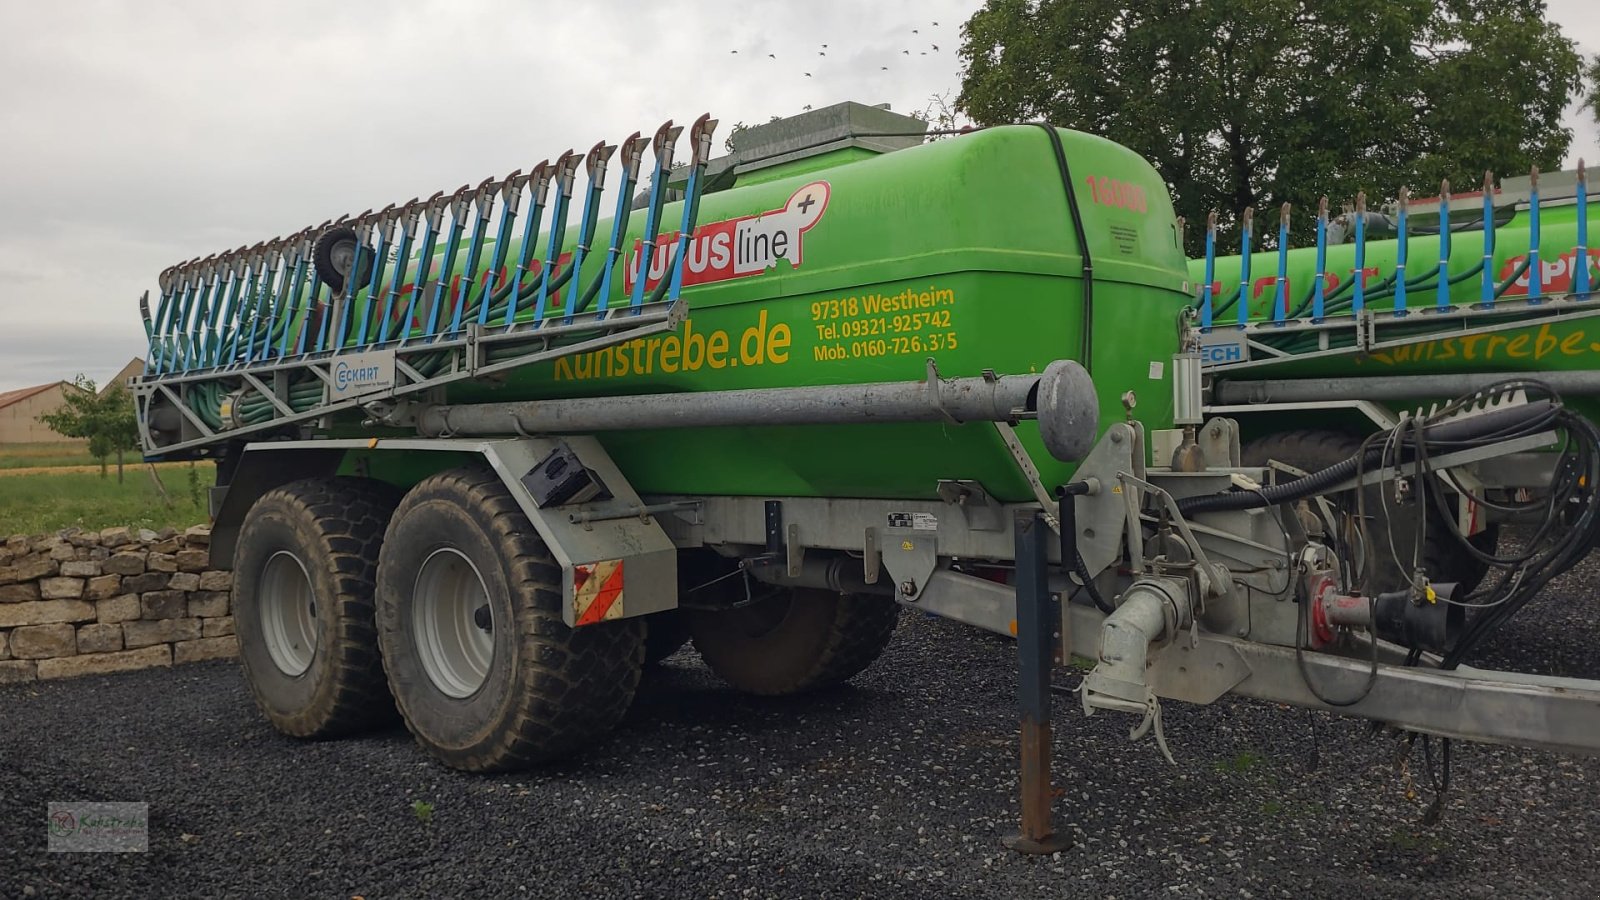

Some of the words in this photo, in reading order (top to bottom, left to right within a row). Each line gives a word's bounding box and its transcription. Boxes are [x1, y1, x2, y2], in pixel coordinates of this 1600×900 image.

[738, 228, 788, 265] line
[811, 297, 859, 321] 97318
[862, 286, 954, 315] Westheim
[816, 323, 840, 341] Tel.
[842, 310, 951, 337] 09321-925742
[814, 343, 850, 361] Mob.
